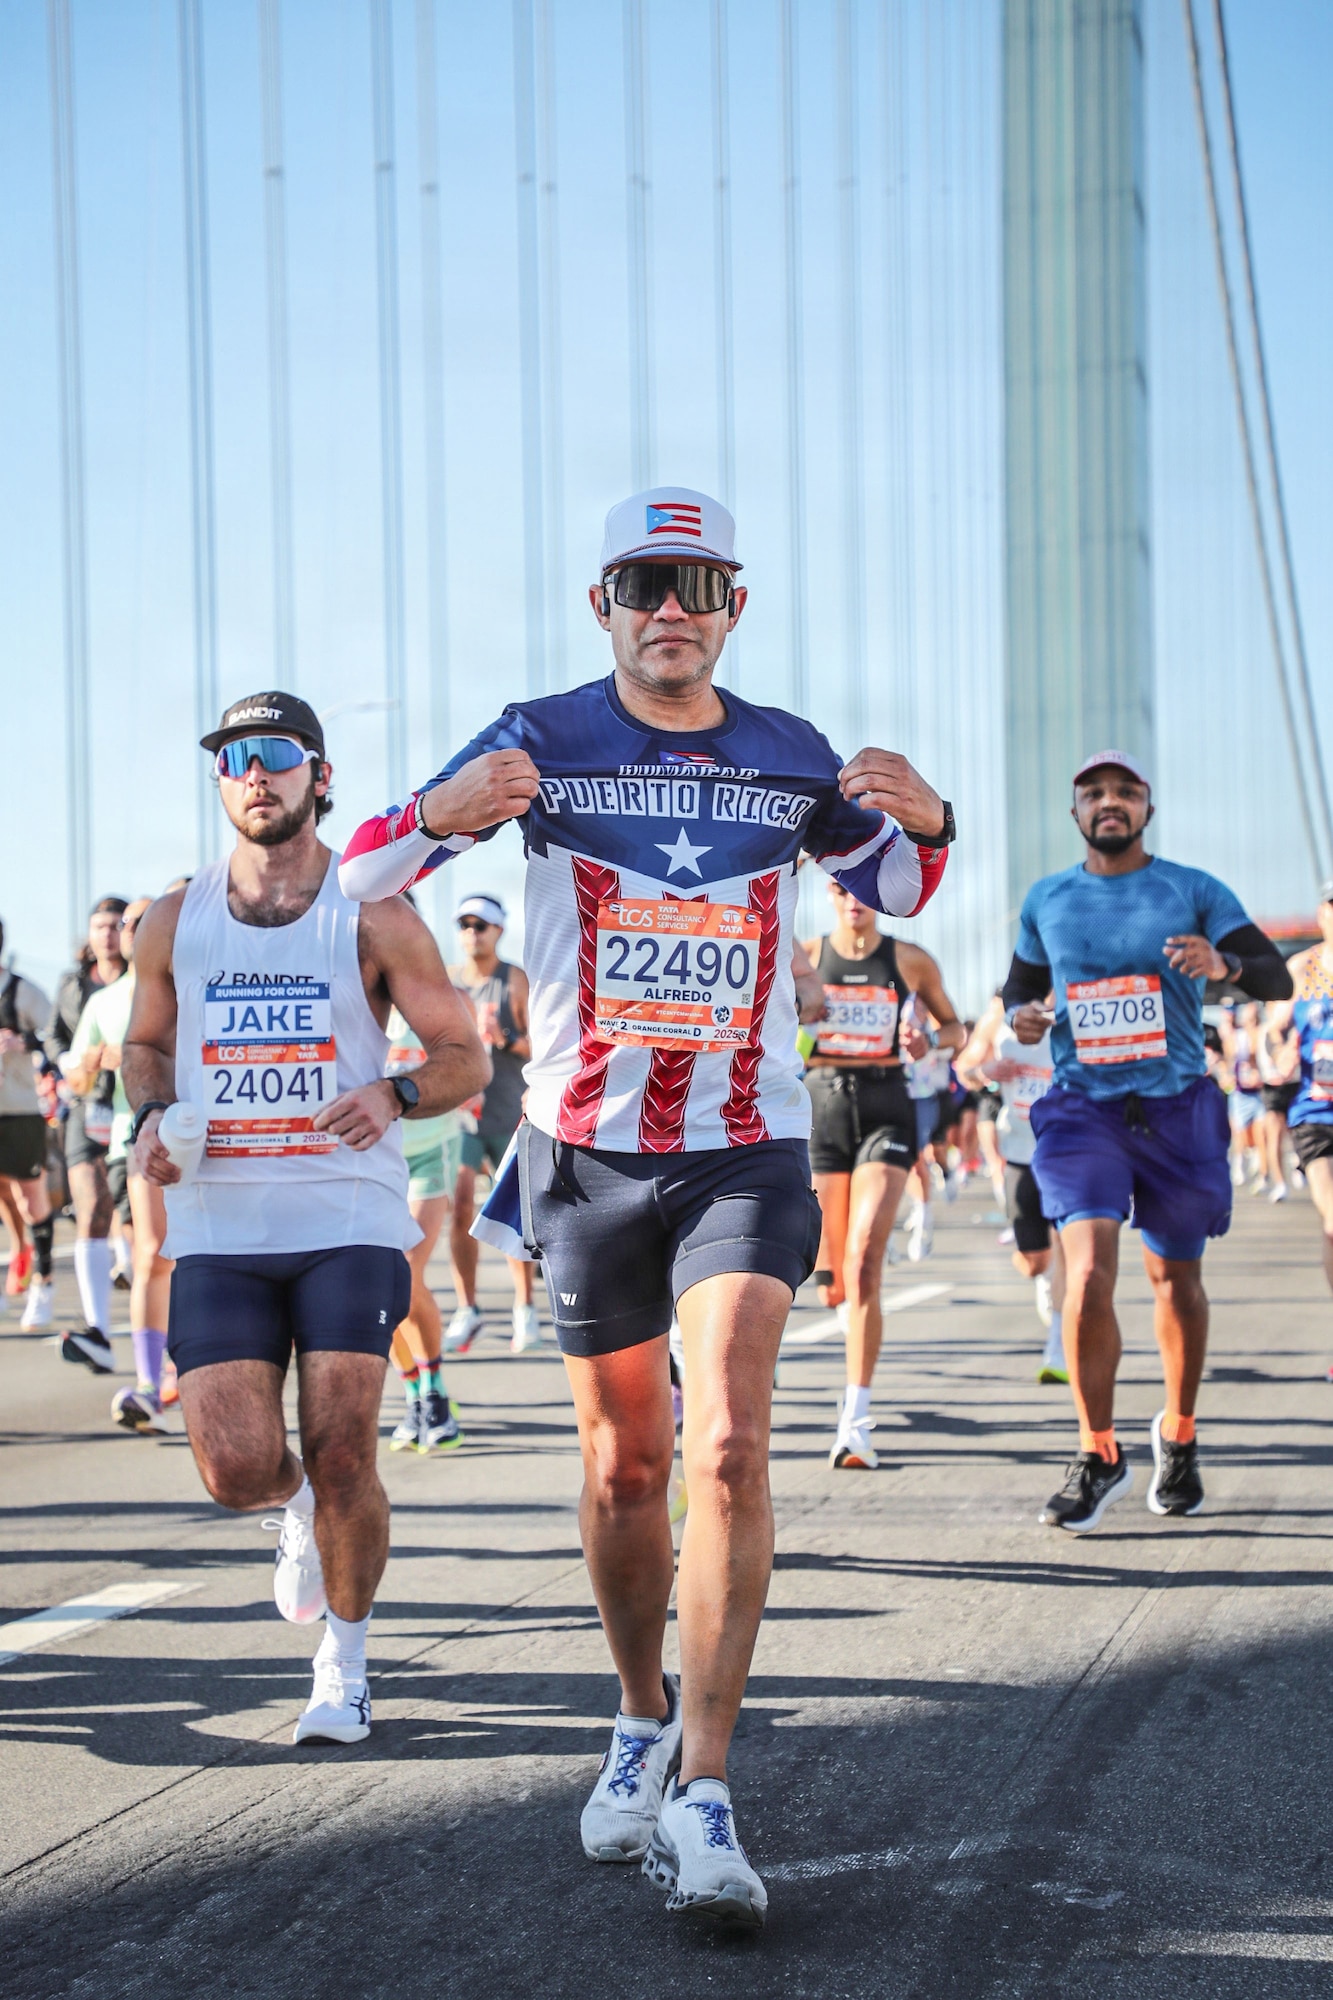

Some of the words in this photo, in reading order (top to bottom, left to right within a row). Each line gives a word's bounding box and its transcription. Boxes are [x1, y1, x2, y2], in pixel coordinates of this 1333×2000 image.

[229, 707, 283, 726] BANDIT
[537, 778, 701, 819] PUERTO
[712, 783, 817, 831] RICO
[658, 905, 679, 914] TATA
[657, 913, 707, 924] CONSULTANCY
[657, 921, 689, 930] SERVICES
[719, 924, 743, 934] TATA
[605, 935, 750, 989] 22490
[216, 987, 262, 998] RUNNING
[264, 986, 285, 997] FOR
[286, 986, 319, 996] OWEN
[643, 987, 712, 1003] ALFREDO
[222, 1005, 313, 1032] JAKE
[1076, 997, 1156, 1028] 25708
[620, 1021, 628, 1030] 2
[632, 1024, 661, 1033] ORANGE
[663, 1026, 691, 1035] CORRAL
[693, 1027, 702, 1037] D
[714, 1029, 739, 1039] 2025
[297, 1051, 319, 1059] TATA
[213, 1066, 323, 1104] 24041
[226, 1137, 231, 1145] 2
[303, 1134, 327, 1143] 2025
